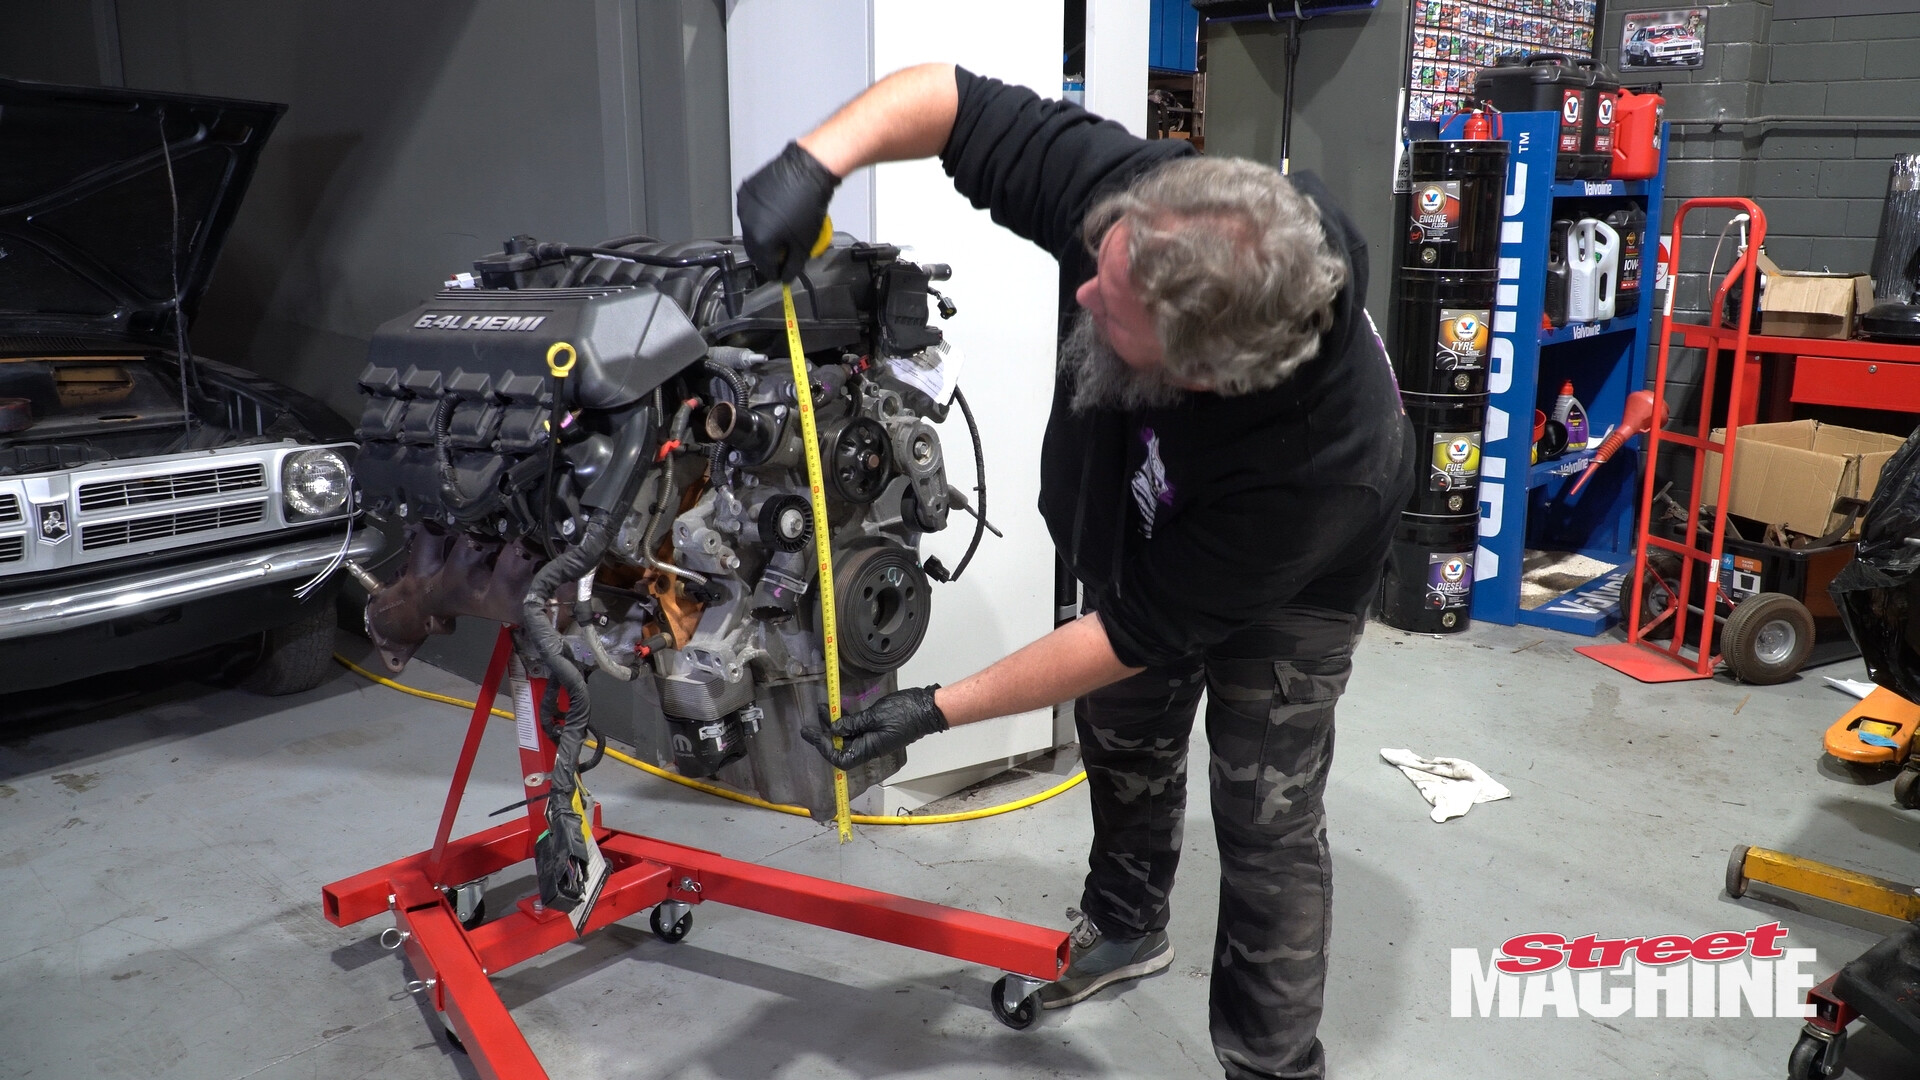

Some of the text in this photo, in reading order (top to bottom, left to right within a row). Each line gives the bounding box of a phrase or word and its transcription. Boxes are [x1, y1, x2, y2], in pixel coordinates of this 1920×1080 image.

[1584, 181, 1613, 196] Valvoline
[1419, 214, 1447, 223] ENGINE
[414, 314, 547, 332] 6.4L HEMI
[1573, 323, 1601, 340] Valvoline
[1451, 341, 1475, 351] TYRE
[1445, 463, 1465, 472] FUEL
[1560, 458, 1589, 474] Valvoline
[1436, 582, 1463, 591] DIESEL
